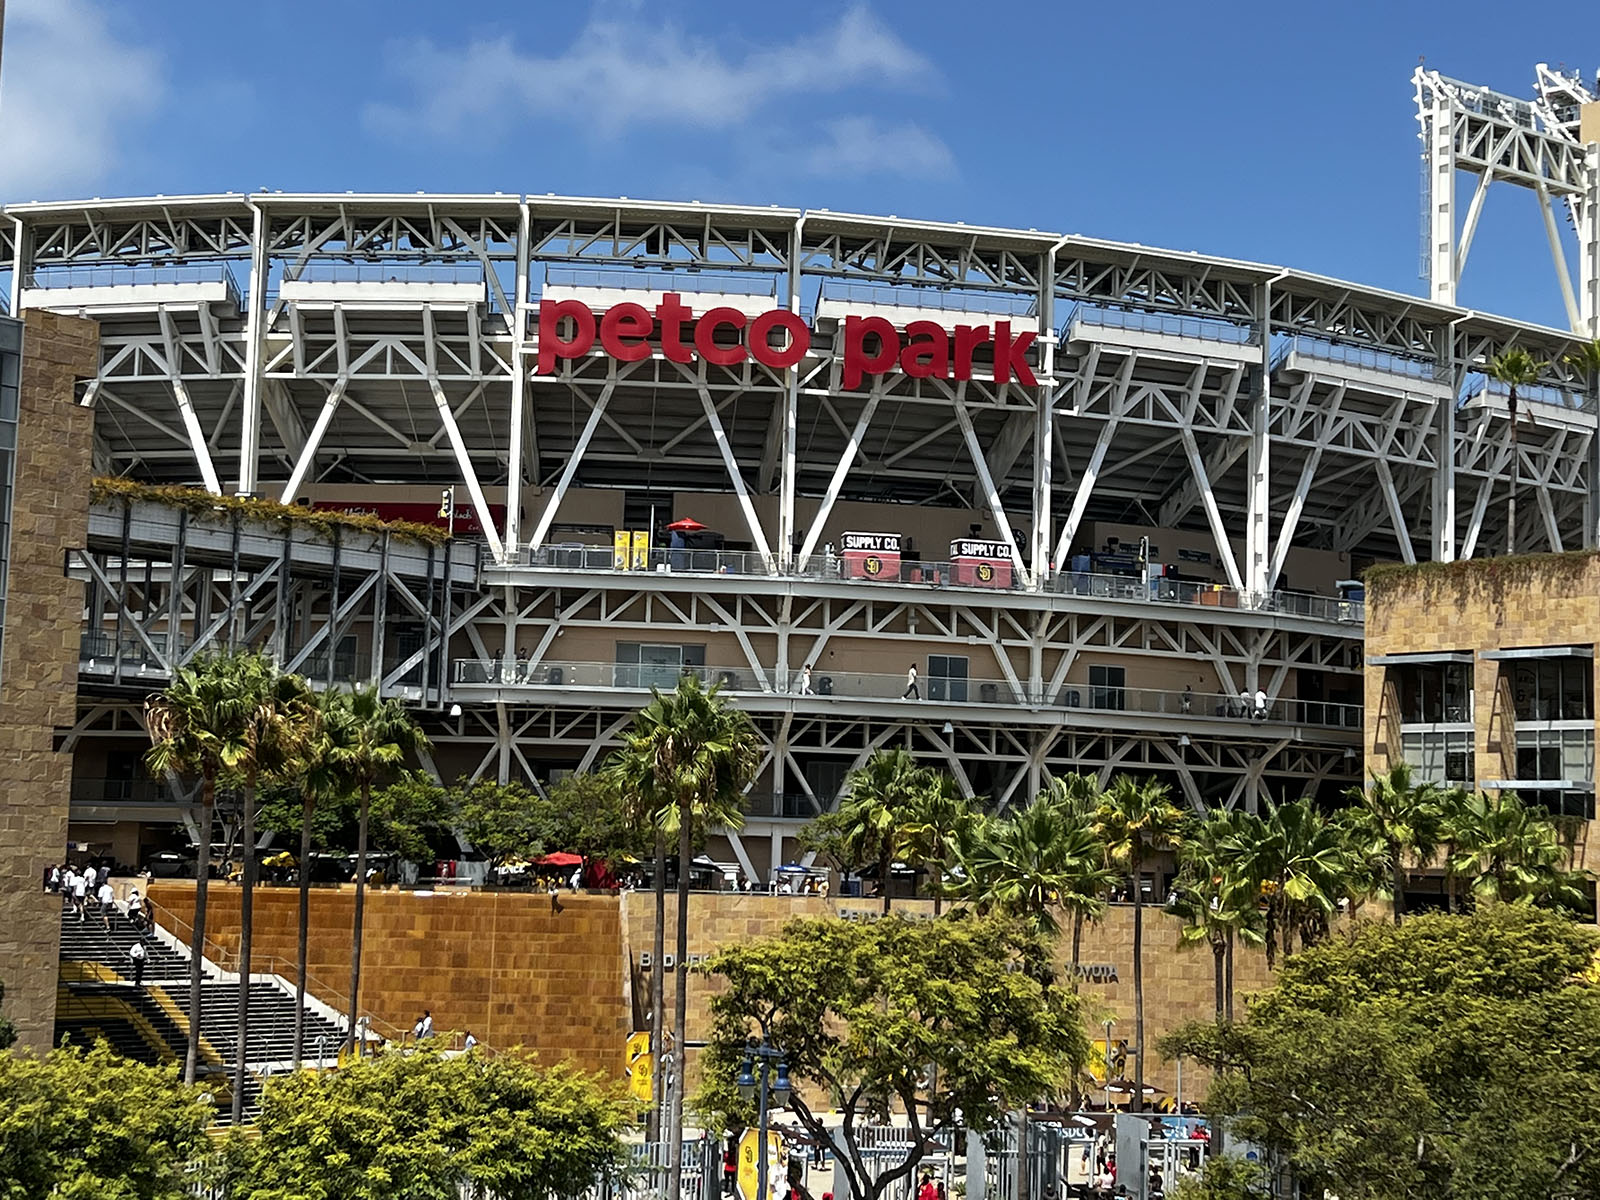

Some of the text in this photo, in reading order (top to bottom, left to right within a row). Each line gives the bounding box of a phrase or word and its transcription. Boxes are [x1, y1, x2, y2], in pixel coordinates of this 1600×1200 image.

[538, 293, 1038, 390] petco park
[846, 535, 882, 549] SUPPLY
[884, 537, 900, 550] CO.
[961, 542, 995, 556] SUPPLY
[996, 545, 1011, 557] CO.
